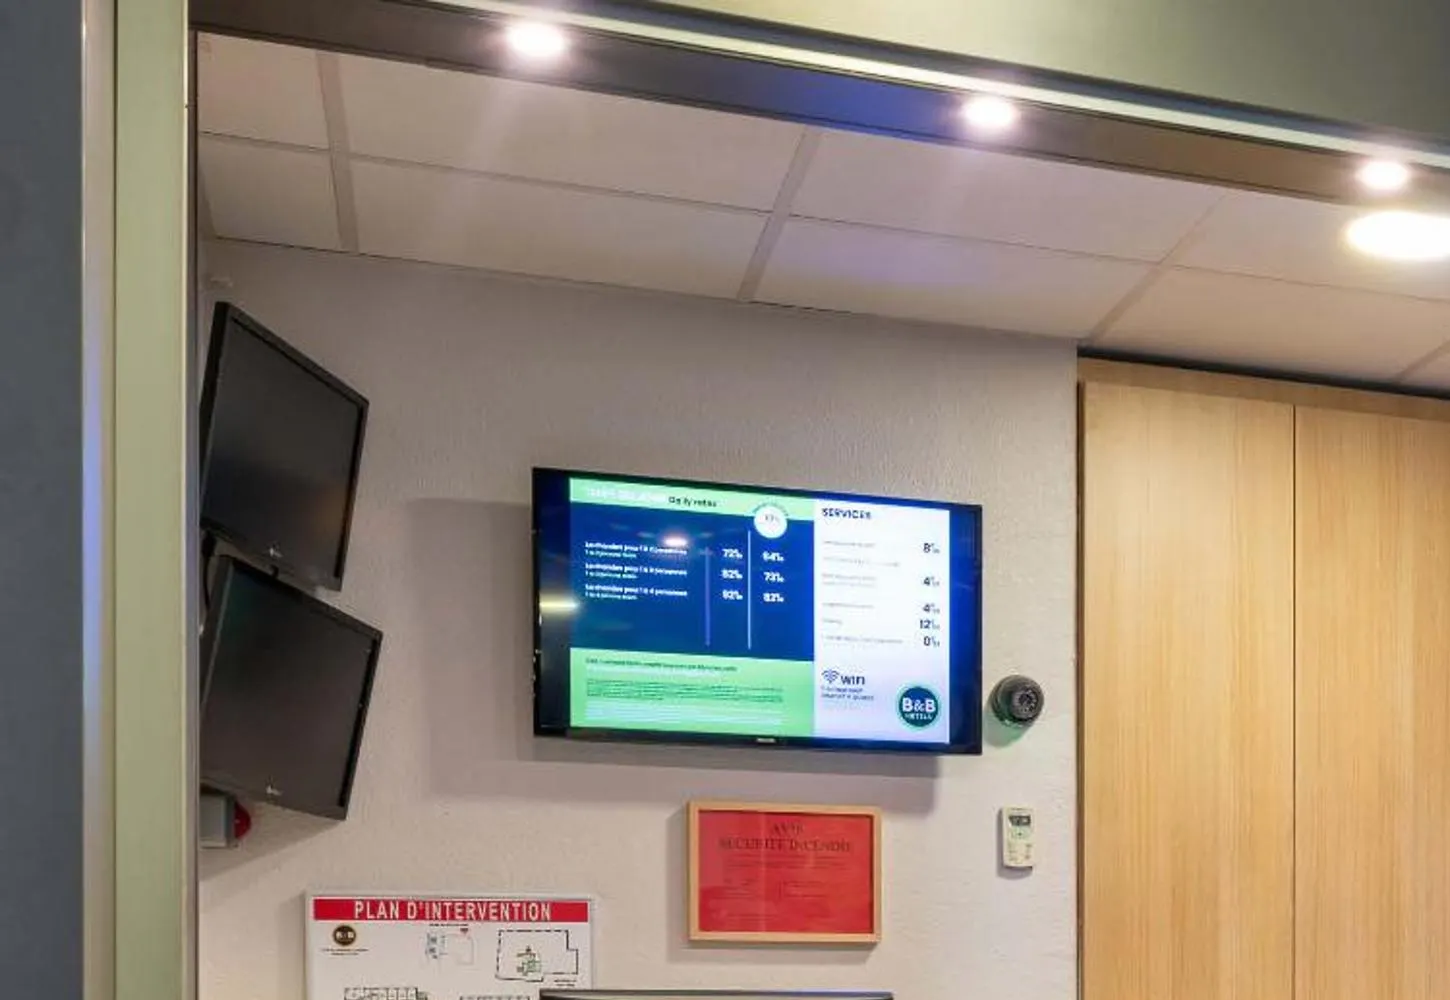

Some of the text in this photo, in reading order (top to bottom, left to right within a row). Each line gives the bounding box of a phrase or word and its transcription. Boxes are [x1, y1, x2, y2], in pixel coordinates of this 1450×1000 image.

[902, 697, 936, 712] B&B
[354, 901, 551, 921] PLAN D'INTERVENTION
